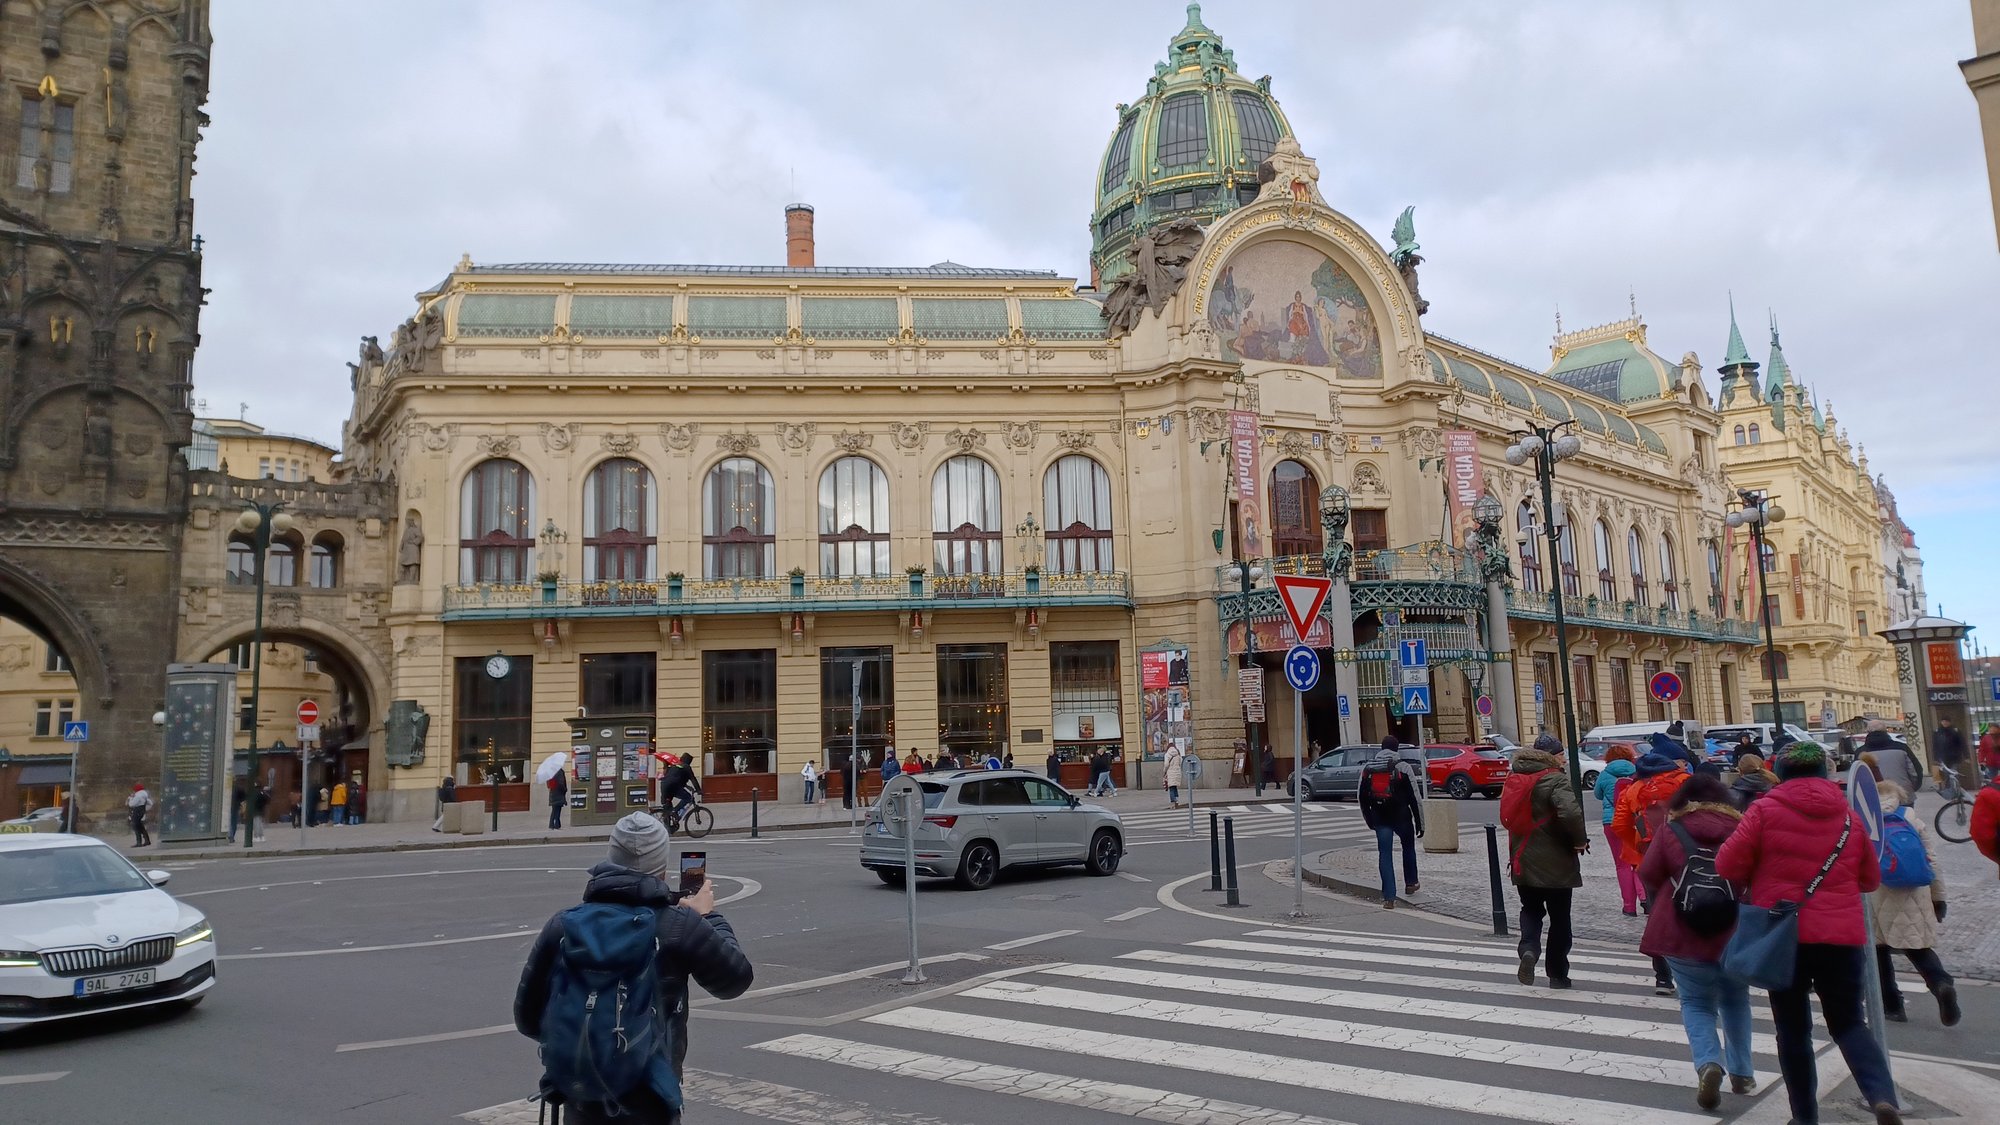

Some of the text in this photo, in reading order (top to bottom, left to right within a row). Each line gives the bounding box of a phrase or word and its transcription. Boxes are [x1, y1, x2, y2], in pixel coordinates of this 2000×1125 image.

[1279, 619, 1324, 639] iMHA
[86, 972, 149, 992] 9AL 2749
